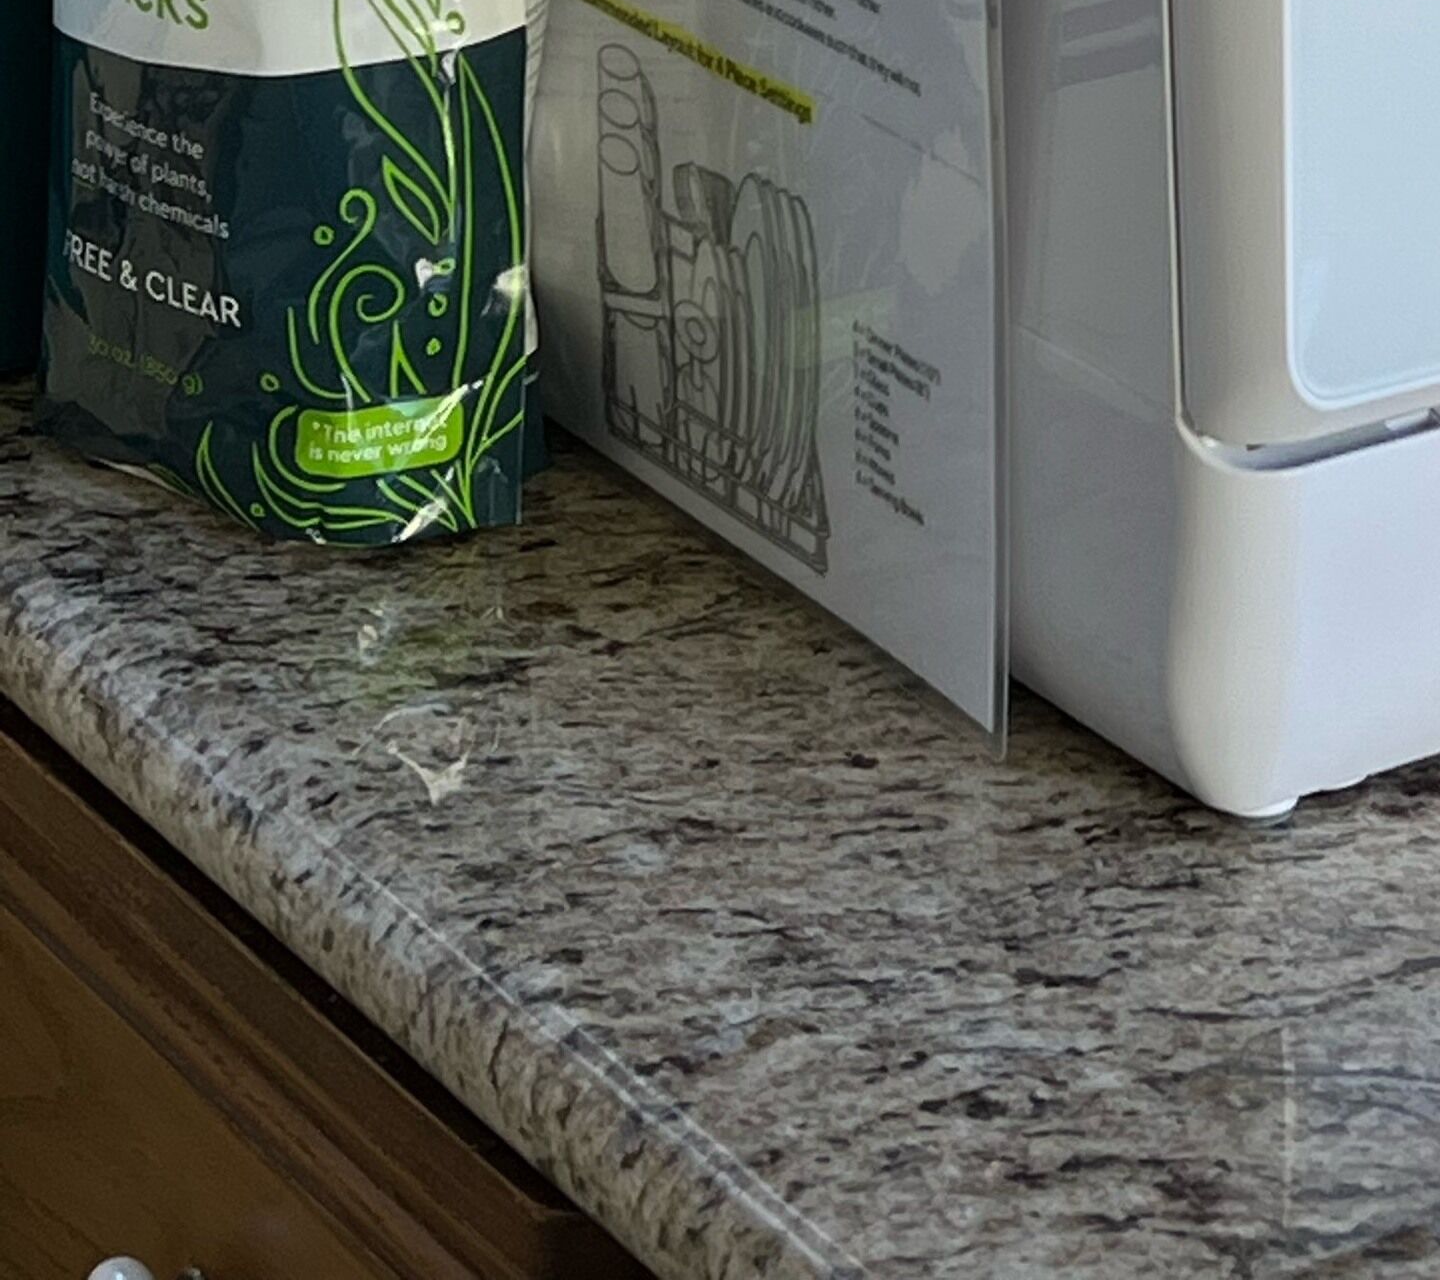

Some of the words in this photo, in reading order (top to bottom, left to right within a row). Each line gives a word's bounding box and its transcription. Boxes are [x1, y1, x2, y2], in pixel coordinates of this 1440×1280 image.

[171, 130, 205, 160] the
[129, 153, 150, 175] of
[151, 162, 213, 204] plants,
[137, 192, 230, 239] chemicals
[63, 228, 113, 282] FREE
[119, 259, 140, 292] &
[145, 270, 242, 329] CLEAR
[364, 417, 448, 443] intern
[327, 446, 383, 464] never
